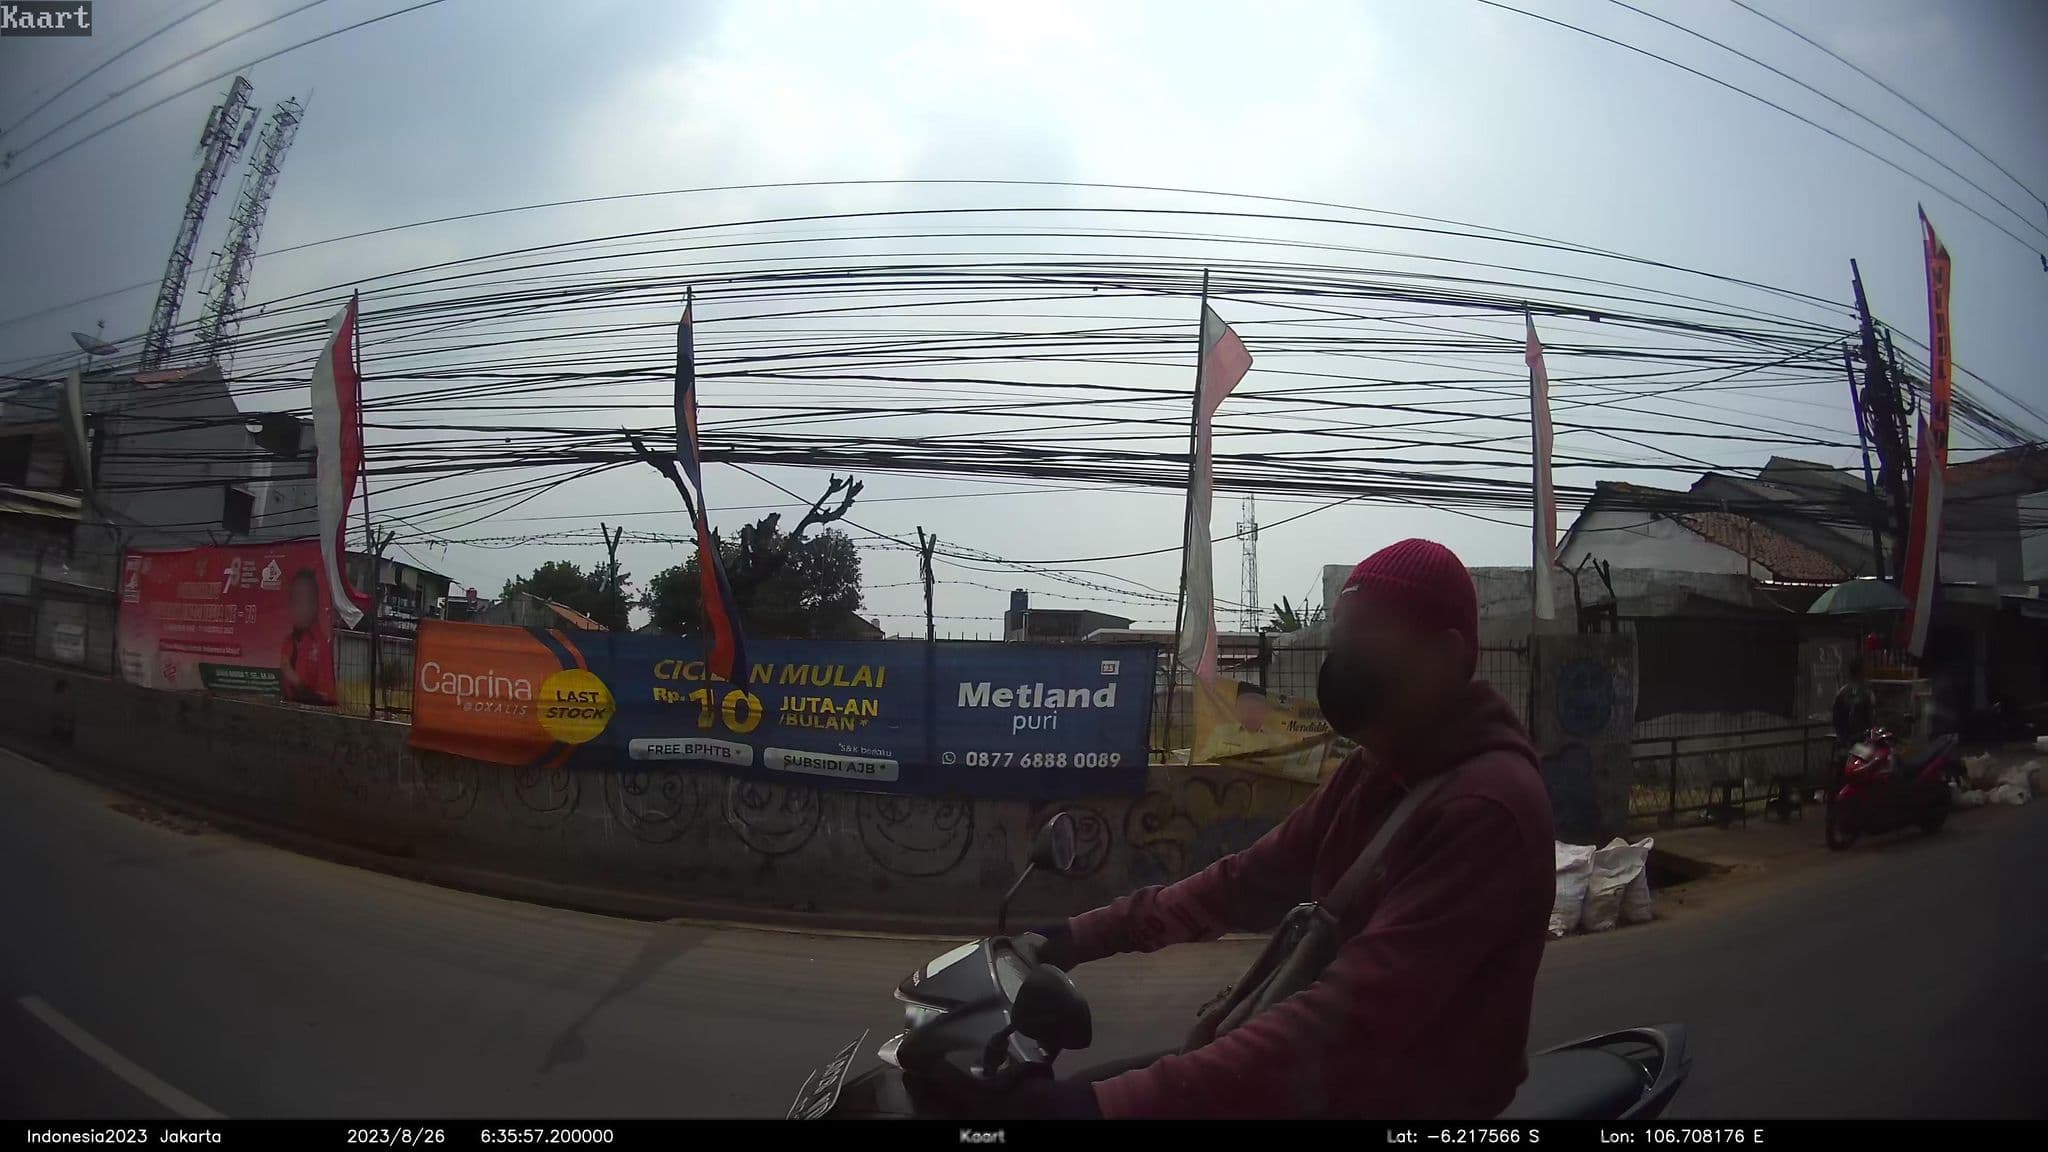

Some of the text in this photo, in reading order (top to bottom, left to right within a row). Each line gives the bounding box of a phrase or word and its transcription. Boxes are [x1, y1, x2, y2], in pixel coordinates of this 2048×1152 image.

[420, 661, 532, 711] Caprina
[779, 664, 887, 689] MULAI
[556, 689, 600, 704] LAST
[957, 681, 1117, 709] Metland
[546, 705, 606, 721] STOCK
[652, 687, 763, 734] Rp. 10
[779, 696, 879, 717] JUTA-AN
[1012, 710, 1057, 735] puri
[647, 744, 732, 759] FREE BPHTB
[965, 751, 1121, 769] 0877 6888 0089
[783, 754, 876, 775] SUBSIDI AJB
